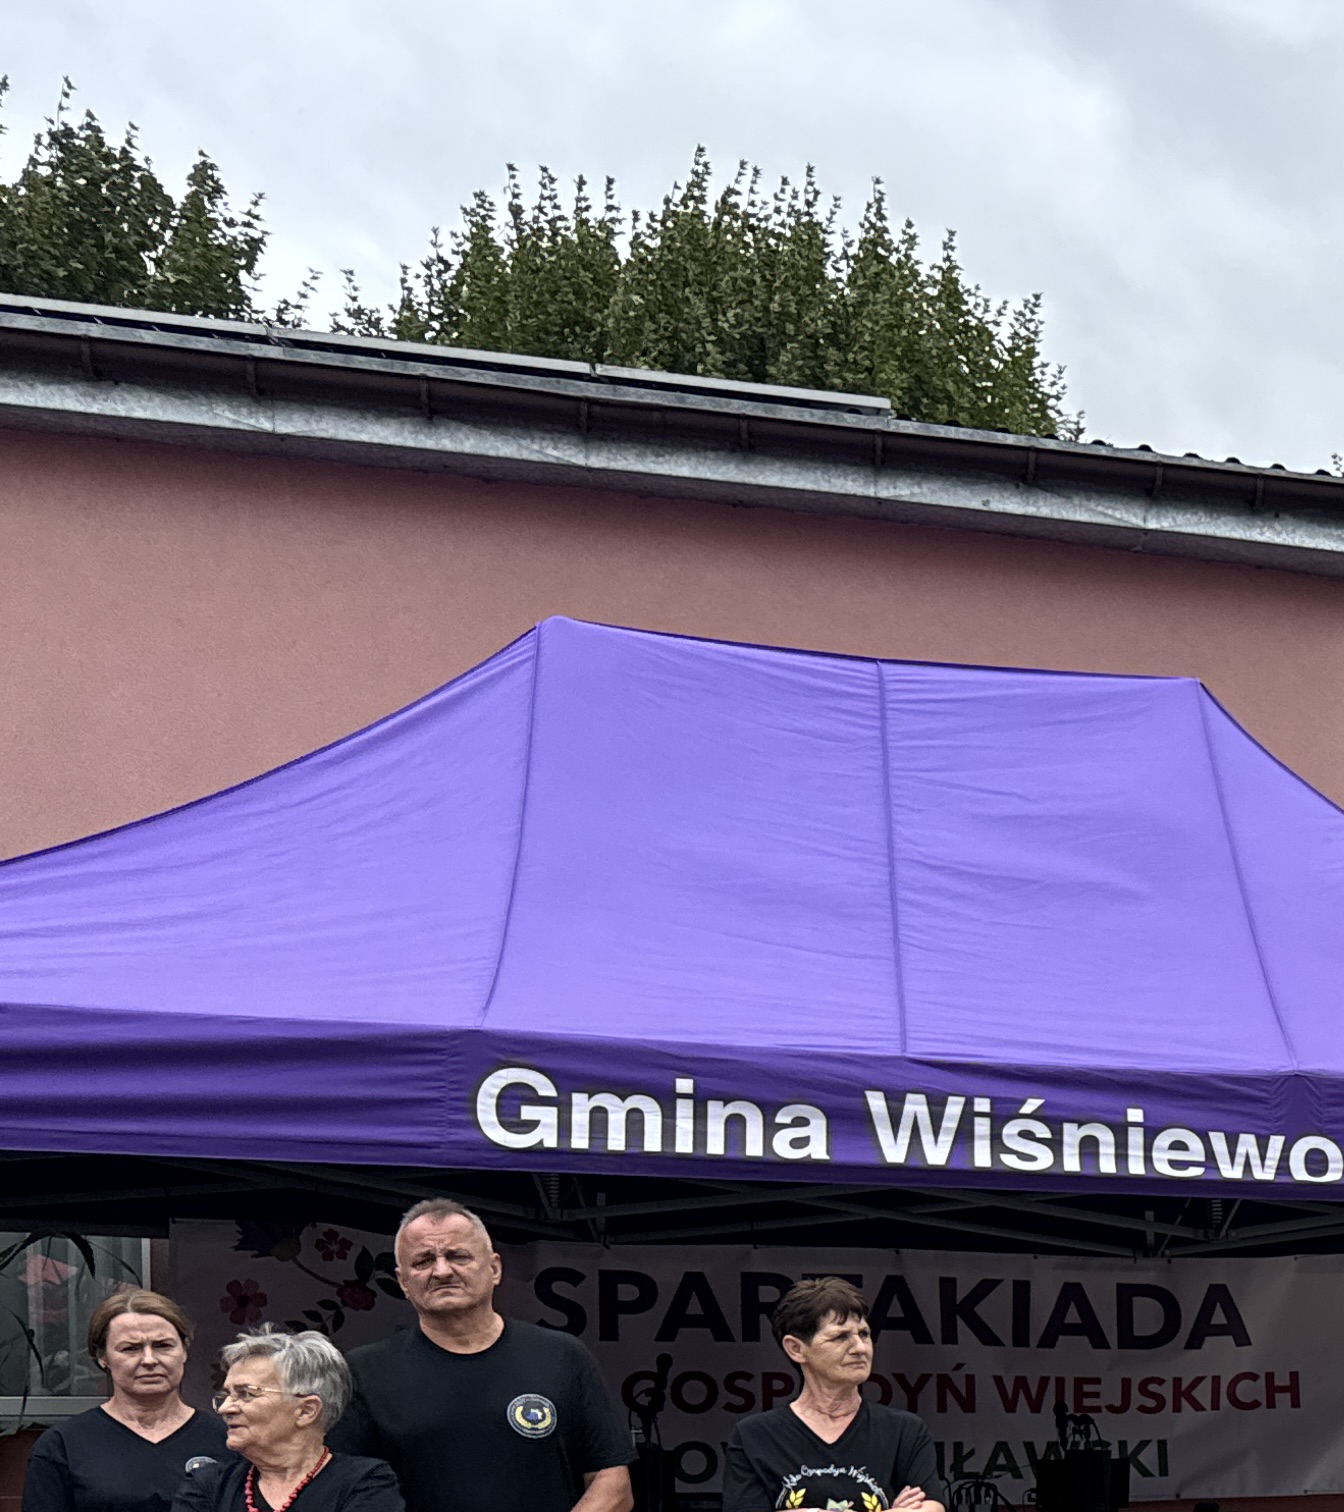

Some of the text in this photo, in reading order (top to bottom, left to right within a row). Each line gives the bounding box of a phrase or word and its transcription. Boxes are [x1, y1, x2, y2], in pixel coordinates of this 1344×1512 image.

[476, 1066, 830, 1161] Gmina
[534, 1267, 1252, 1350] SPARAKIADA
[621, 1363, 1301, 1414] GOSPDYŃ WIEJSKICH
[934, 1439, 1168, 1480] ŁAWKI
